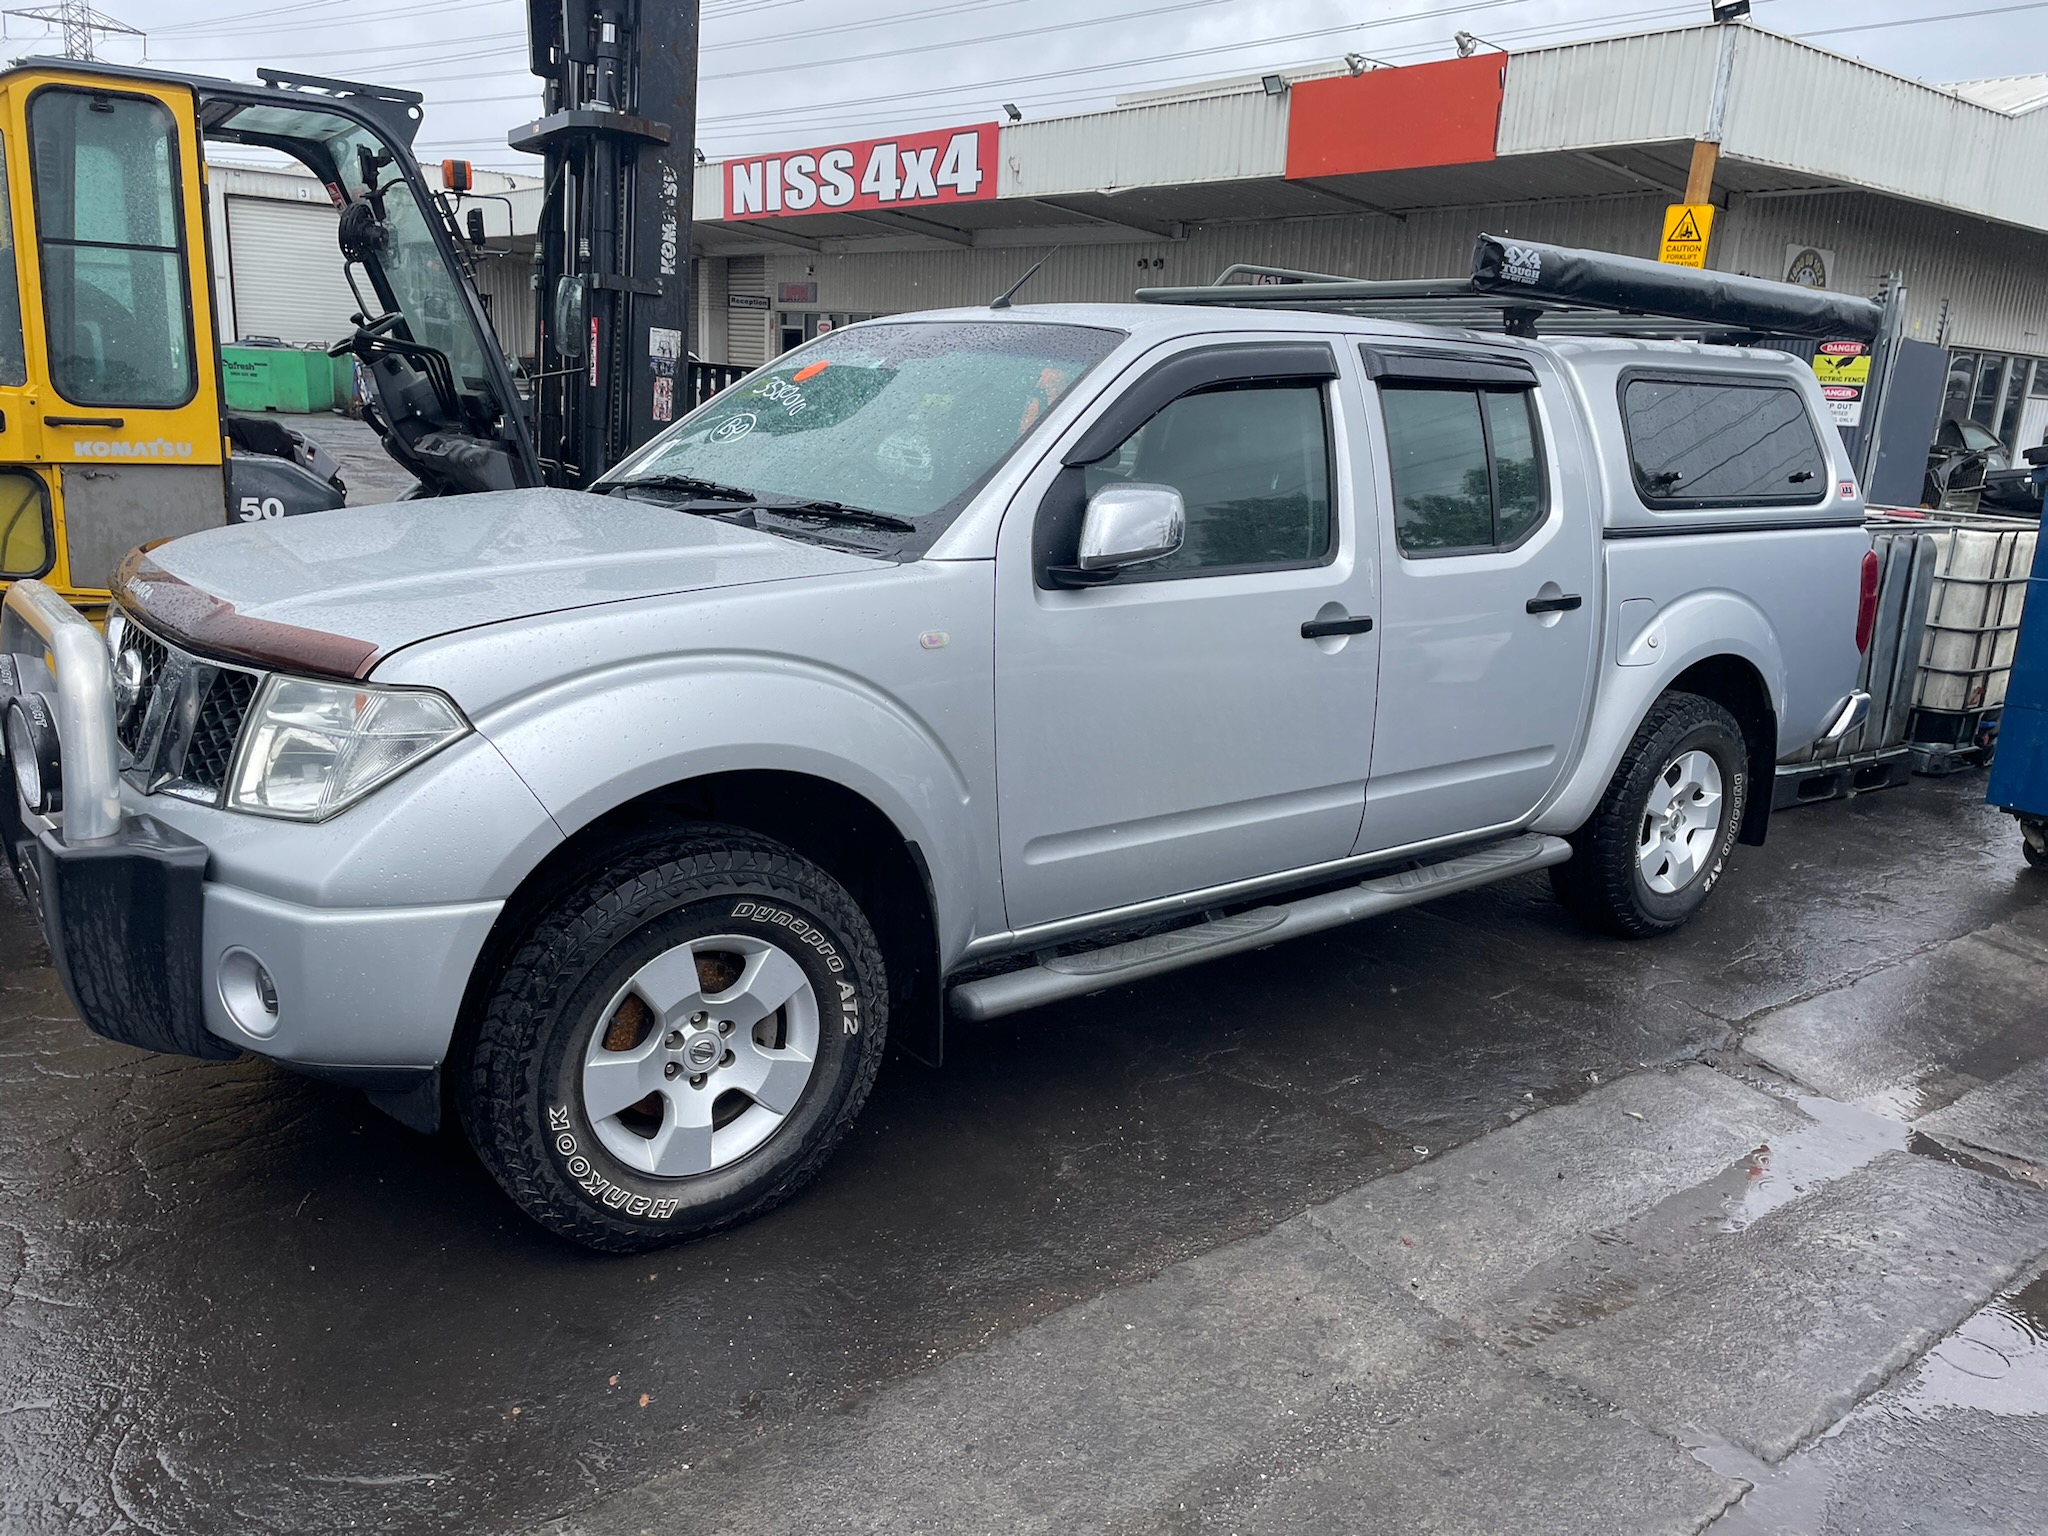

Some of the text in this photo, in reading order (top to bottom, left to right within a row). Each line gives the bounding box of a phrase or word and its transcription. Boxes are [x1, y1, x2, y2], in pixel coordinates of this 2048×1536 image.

[732, 130, 984, 216] NISS 4x4
[301, 189, 306, 198] 3
[1501, 262, 1540, 278] TOUGH
[731, 297, 768, 306] Reception
[1826, 344, 1862, 353] DANGER
[74, 438, 192, 457] KOMATSU
[240, 497, 285, 521] 50
[731, 902, 859, 1035] Dynapro AT2
